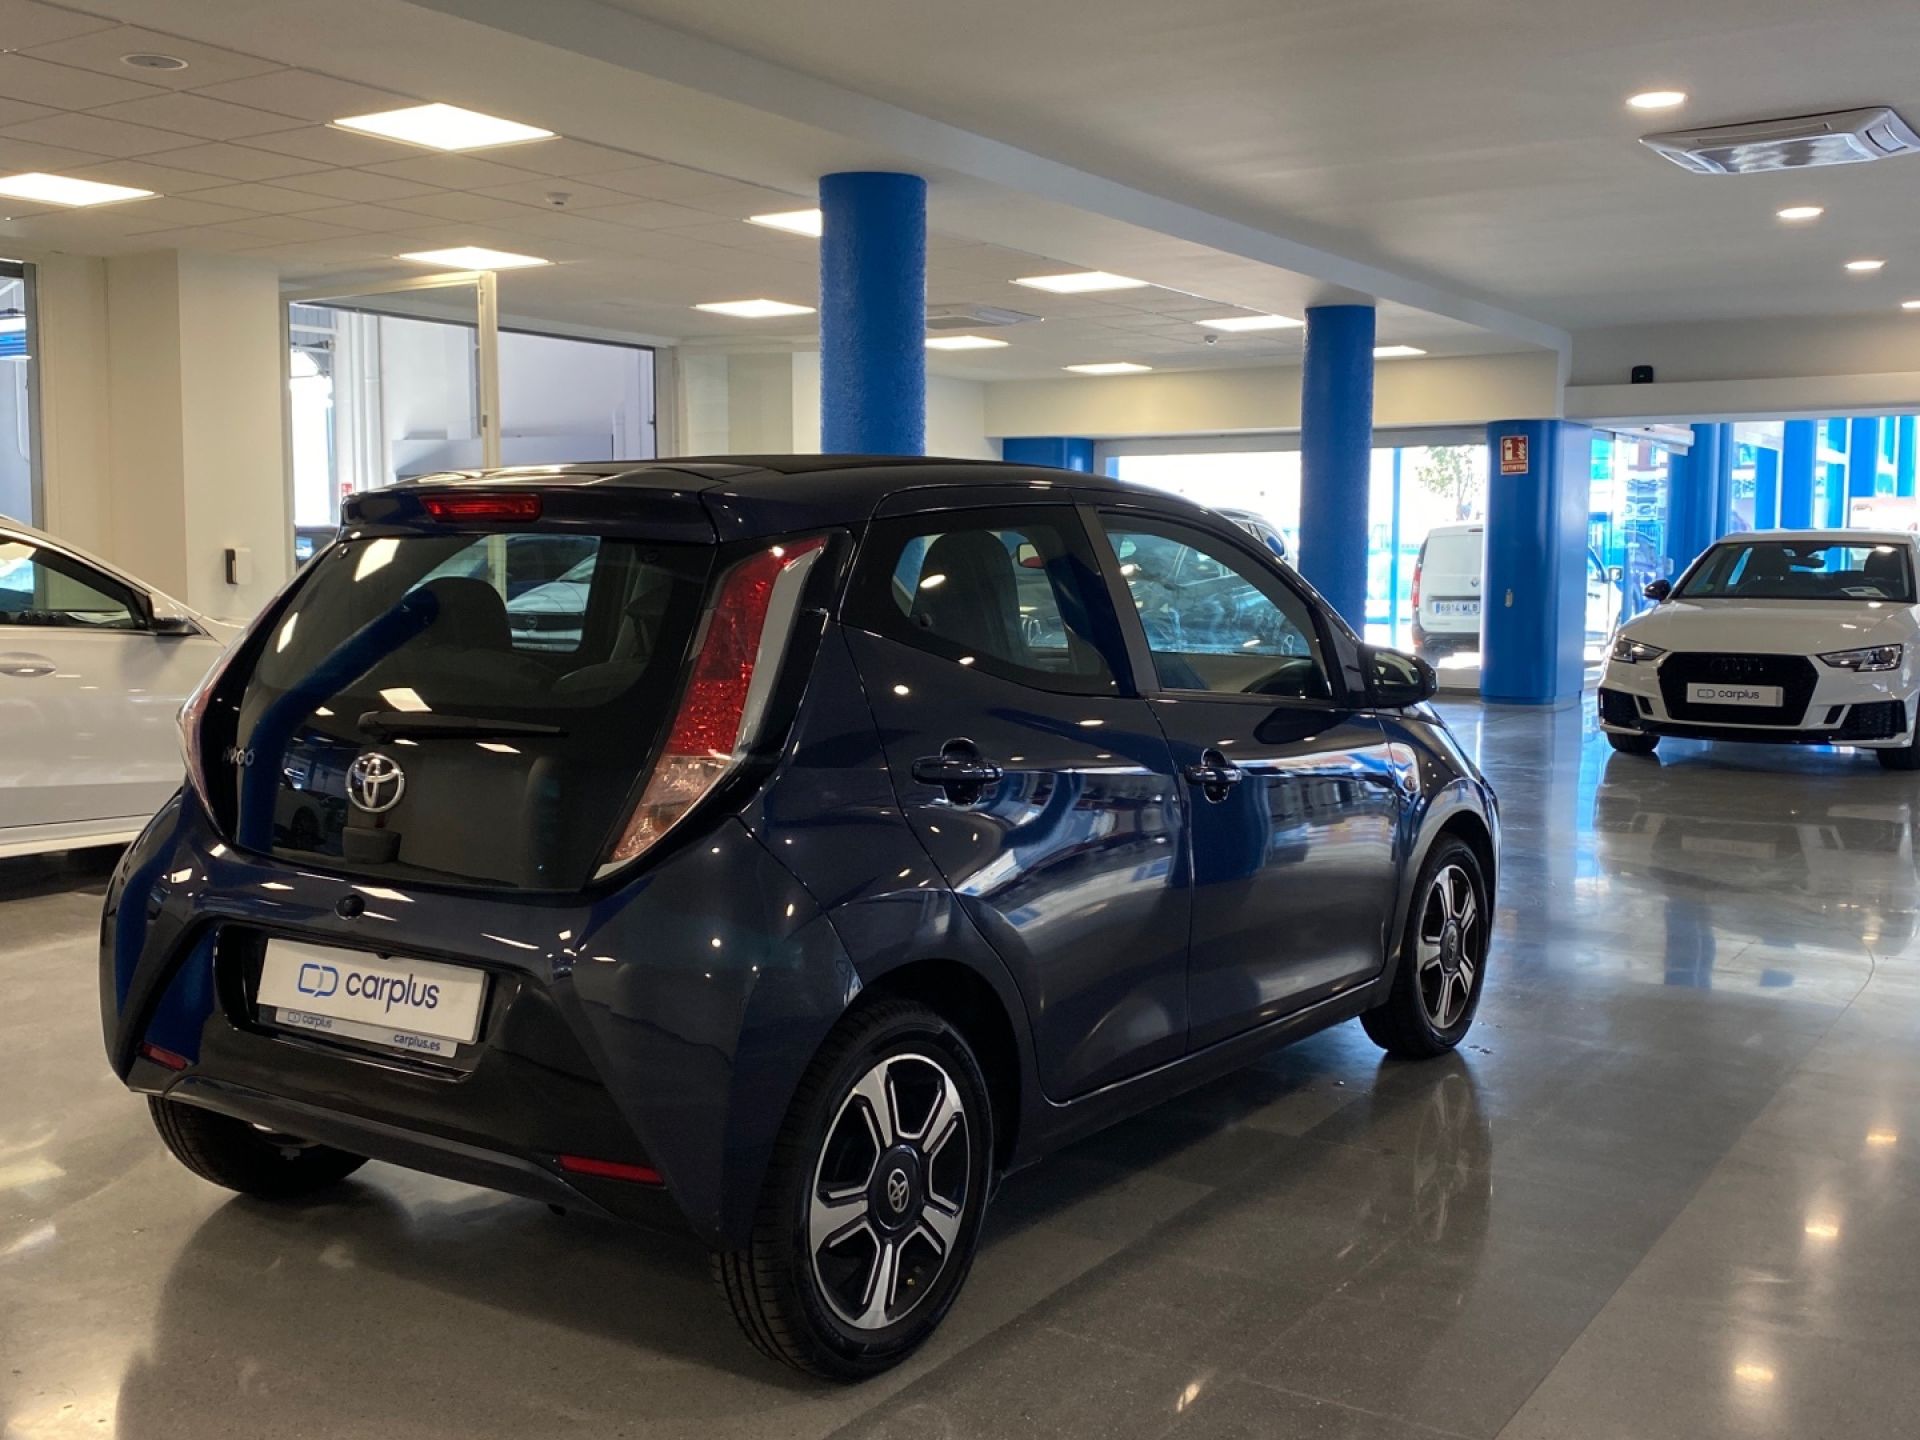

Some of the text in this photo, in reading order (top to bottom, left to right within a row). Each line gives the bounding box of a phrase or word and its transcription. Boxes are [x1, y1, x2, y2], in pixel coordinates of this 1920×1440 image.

[1718, 689, 1760, 702] carplus
[345, 973, 440, 1014] carplus
[302, 1014, 333, 1030] carplus
[393, 1032, 441, 1052] carplus.es
